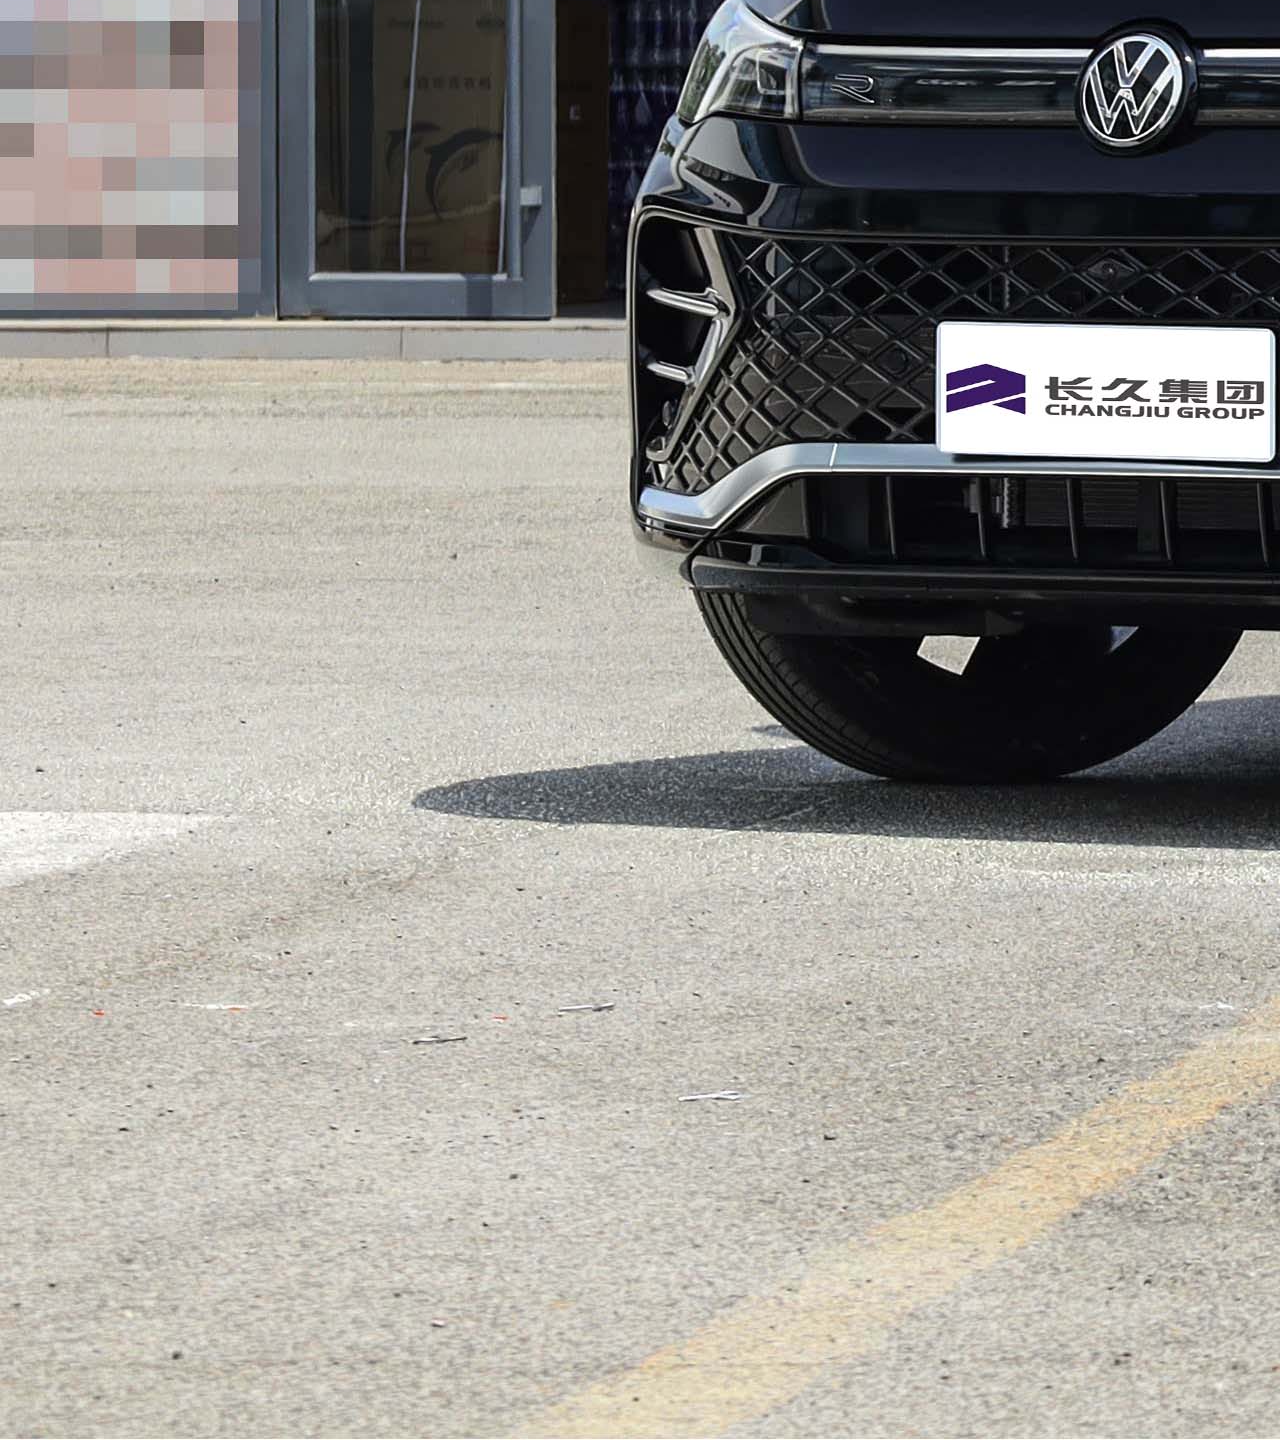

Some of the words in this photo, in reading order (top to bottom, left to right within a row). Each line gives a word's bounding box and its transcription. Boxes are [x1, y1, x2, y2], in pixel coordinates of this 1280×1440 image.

[1044, 376, 1265, 405] 长久集团
[1045, 404, 1170, 419] CHANGJIU
[1177, 406, 1265, 420] GROUP
